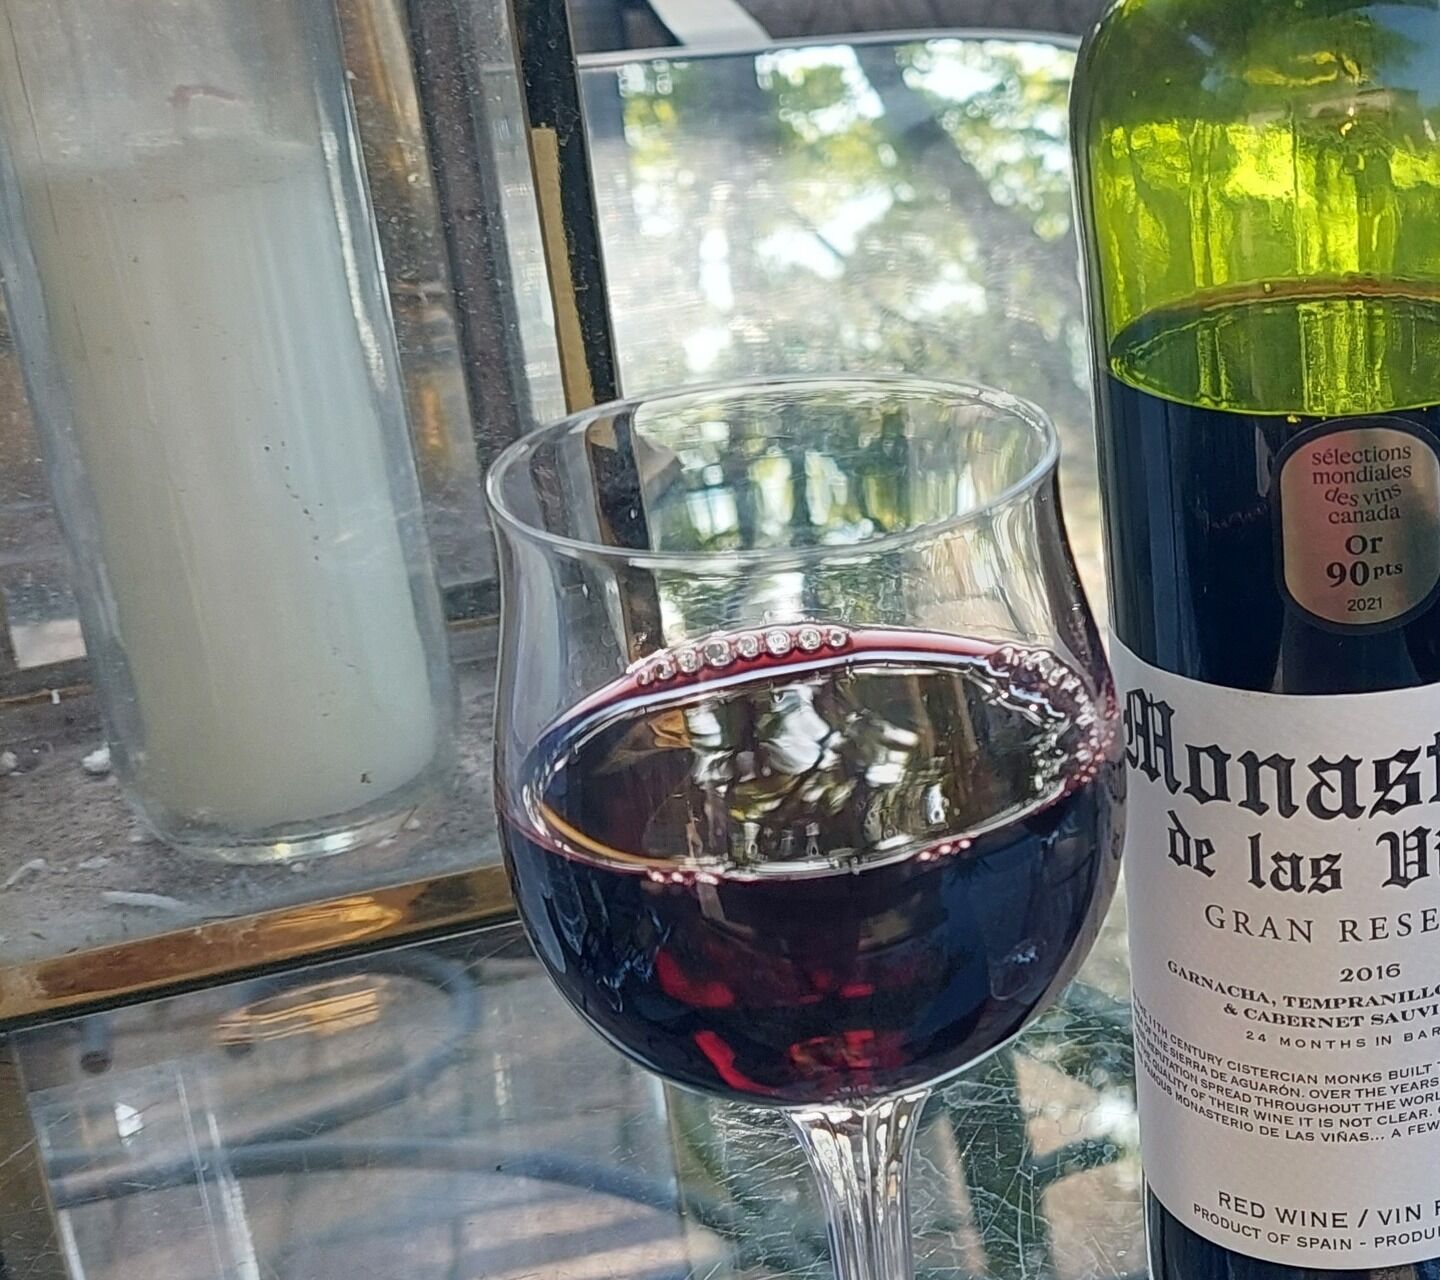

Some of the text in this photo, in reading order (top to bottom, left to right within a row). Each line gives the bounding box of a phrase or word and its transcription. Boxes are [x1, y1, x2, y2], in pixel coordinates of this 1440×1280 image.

[1312, 446, 1412, 466] sélections
[1312, 464, 1412, 485] mondiales
[1324, 484, 1402, 507] des vins
[1328, 505, 1401, 525] canada
[1345, 535, 1383, 555] Or
[1347, 597, 1383, 611] 2021
[1167, 810, 1216, 878] de
[1248, 833, 1343, 894] las
[1204, 904, 1314, 944] GRAN
[1167, 960, 1277, 1007] GARNACHA,
[1339, 963, 1401, 983] 2016
[1223, 1002, 1239, 1017] &
[1244, 1006, 1365, 1029] CABERNET
[1246, 1030, 1267, 1043] 24
[1280, 1036, 1366, 1050] MONTHS
[1375, 1034, 1392, 1047] IN
[1153, 1032, 1168, 1052] THE
[1170, 1047, 1208, 1076] SIERRA
[1210, 1068, 1228, 1083] DE
[1230, 1075, 1305, 1098] AGUARÓN.
[1309, 1089, 1351, 1099] OVER
[1355, 1086, 1387, 1098] THE
[1390, 1077, 1439, 1095] YEARS
[1170, 1033, 1223, 1067] CENTURY
[1227, 1060, 1318, 1084] CISTERCIAN
[1325, 1072, 1382, 1085] MONKS
[1388, 1063, 1433, 1081] BUILT
[1190, 1086, 1206, 1101] OF
[1208, 1094, 1249, 1118] THEIR
[1253, 1109, 1294, 1126] WINE
[1299, 1117, 1313, 1127] IT
[1318, 1118, 1333, 1128] IS
[1339, 1117, 1373, 1128] NOT
[1377, 1108, 1433, 1126] CLEAR.
[1200, 1078, 1252, 1104] SPREAD
[1254, 1095, 1361, 1114] THROUGHOUT
[1364, 1100, 1396, 1112] THE
[1175, 1091, 1254, 1132] MONASTERIO
[1259, 1125, 1280, 1138] DE
[1286, 1130, 1315, 1141] LAS
[1391, 1128, 1402, 1139] A
[1408, 1119, 1440, 1136] FEW
[1193, 1203, 1261, 1240] PRODUCT
[1267, 1232, 1291, 1245] OF
[1296, 1236, 1352, 1250] SPAIN
[1218, 1190, 1266, 1219] RED
[1275, 1207, 1348, 1229] WINE
[1357, 1208, 1369, 1228] /
[1377, 1204, 1421, 1226] VIN
